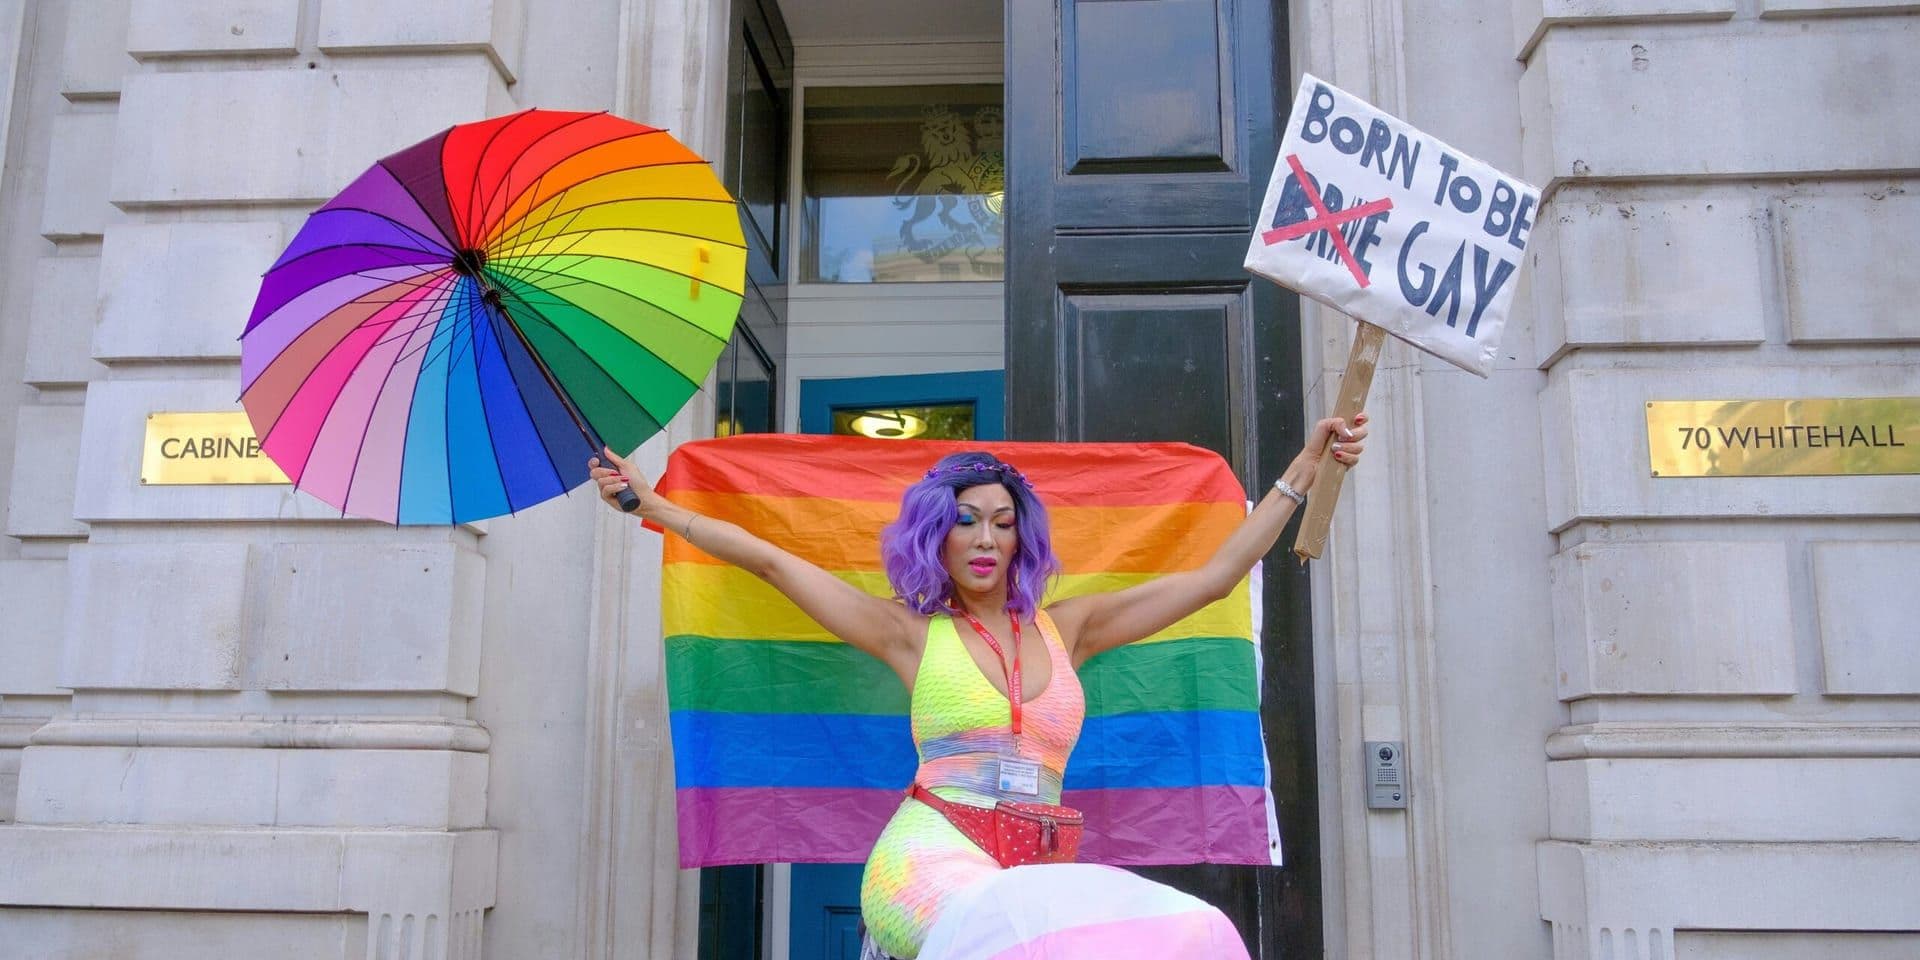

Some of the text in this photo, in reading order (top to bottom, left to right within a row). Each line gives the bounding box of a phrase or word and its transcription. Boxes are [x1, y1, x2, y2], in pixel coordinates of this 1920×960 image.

[1300, 83, 1535, 250] BORN TO BE
[1397, 221, 1516, 338] GAY
[160, 437, 263, 459] CABINE
[1678, 425, 1905, 449] 70 WHITEHALL
